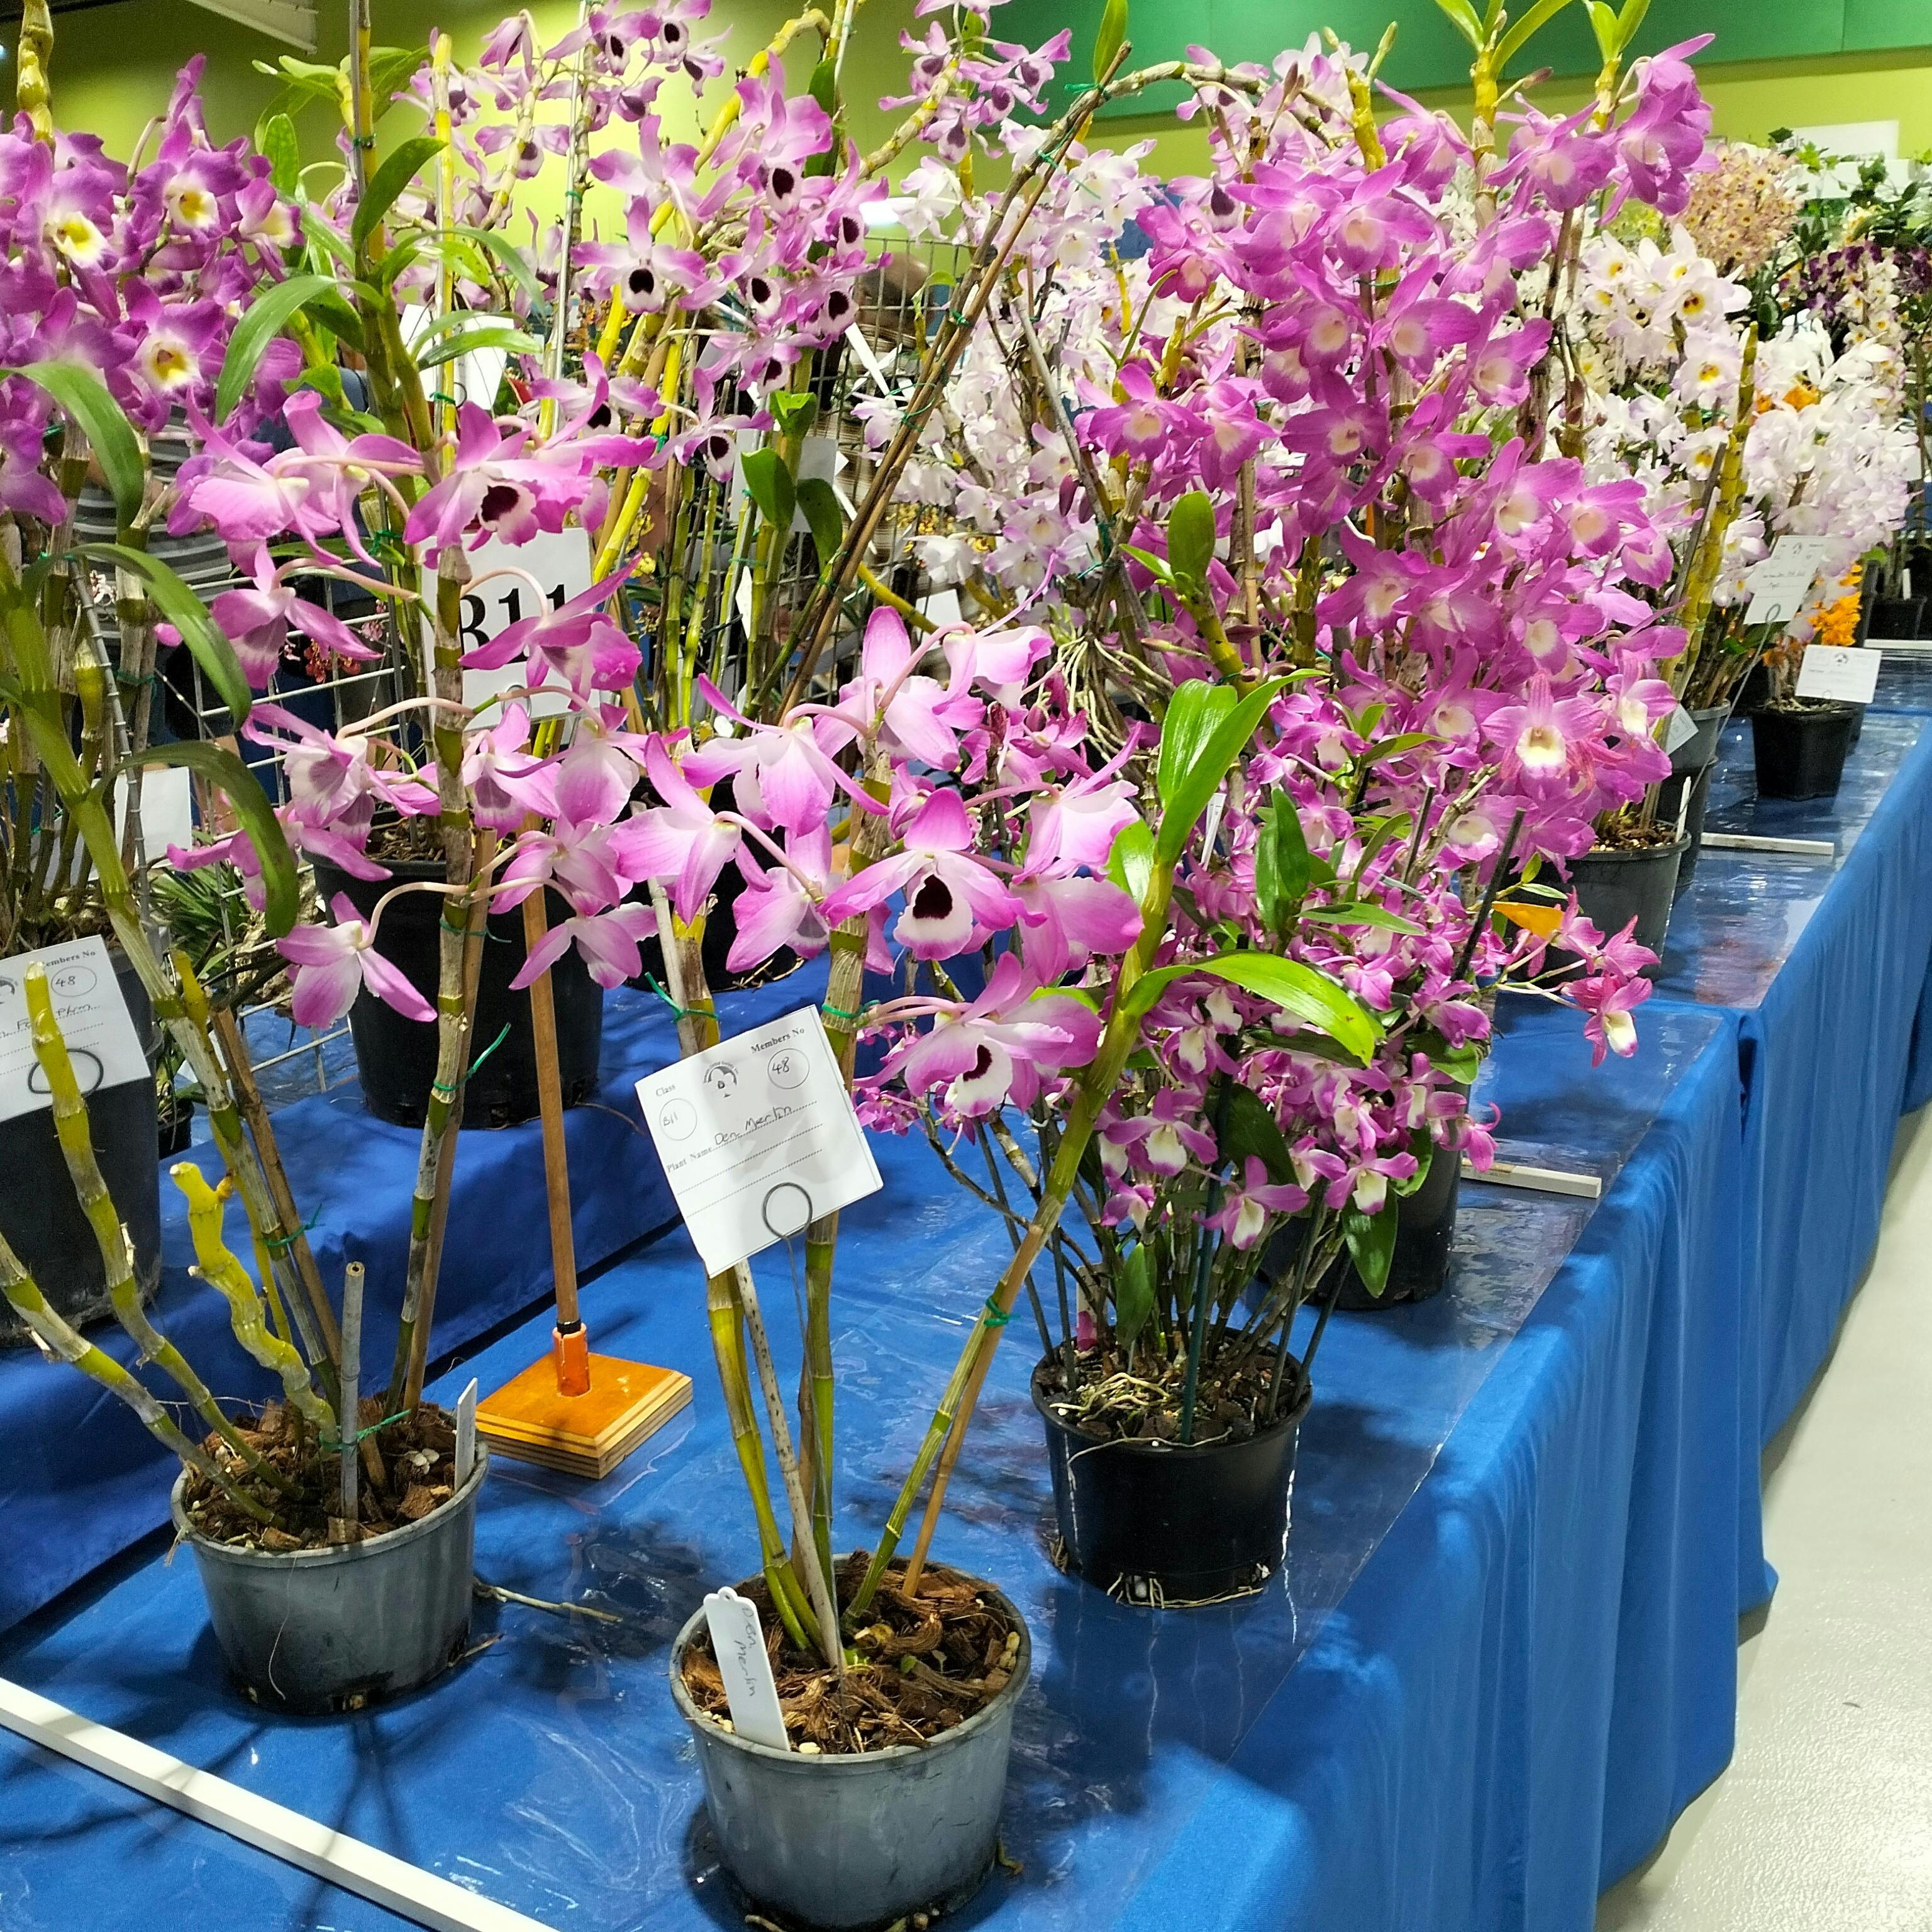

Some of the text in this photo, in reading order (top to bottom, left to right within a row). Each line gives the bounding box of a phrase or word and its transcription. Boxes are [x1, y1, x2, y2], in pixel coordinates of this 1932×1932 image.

[42, 955, 80, 967] embers
[55, 975, 75, 987] 48
[750, 1028, 805, 1054] Members No
[772, 1056, 790, 1075] 48
[656, 1084, 677, 1097] Class
[667, 1146, 713, 1173] Plant Name
[734, 1640, 757, 1697] Merlin
